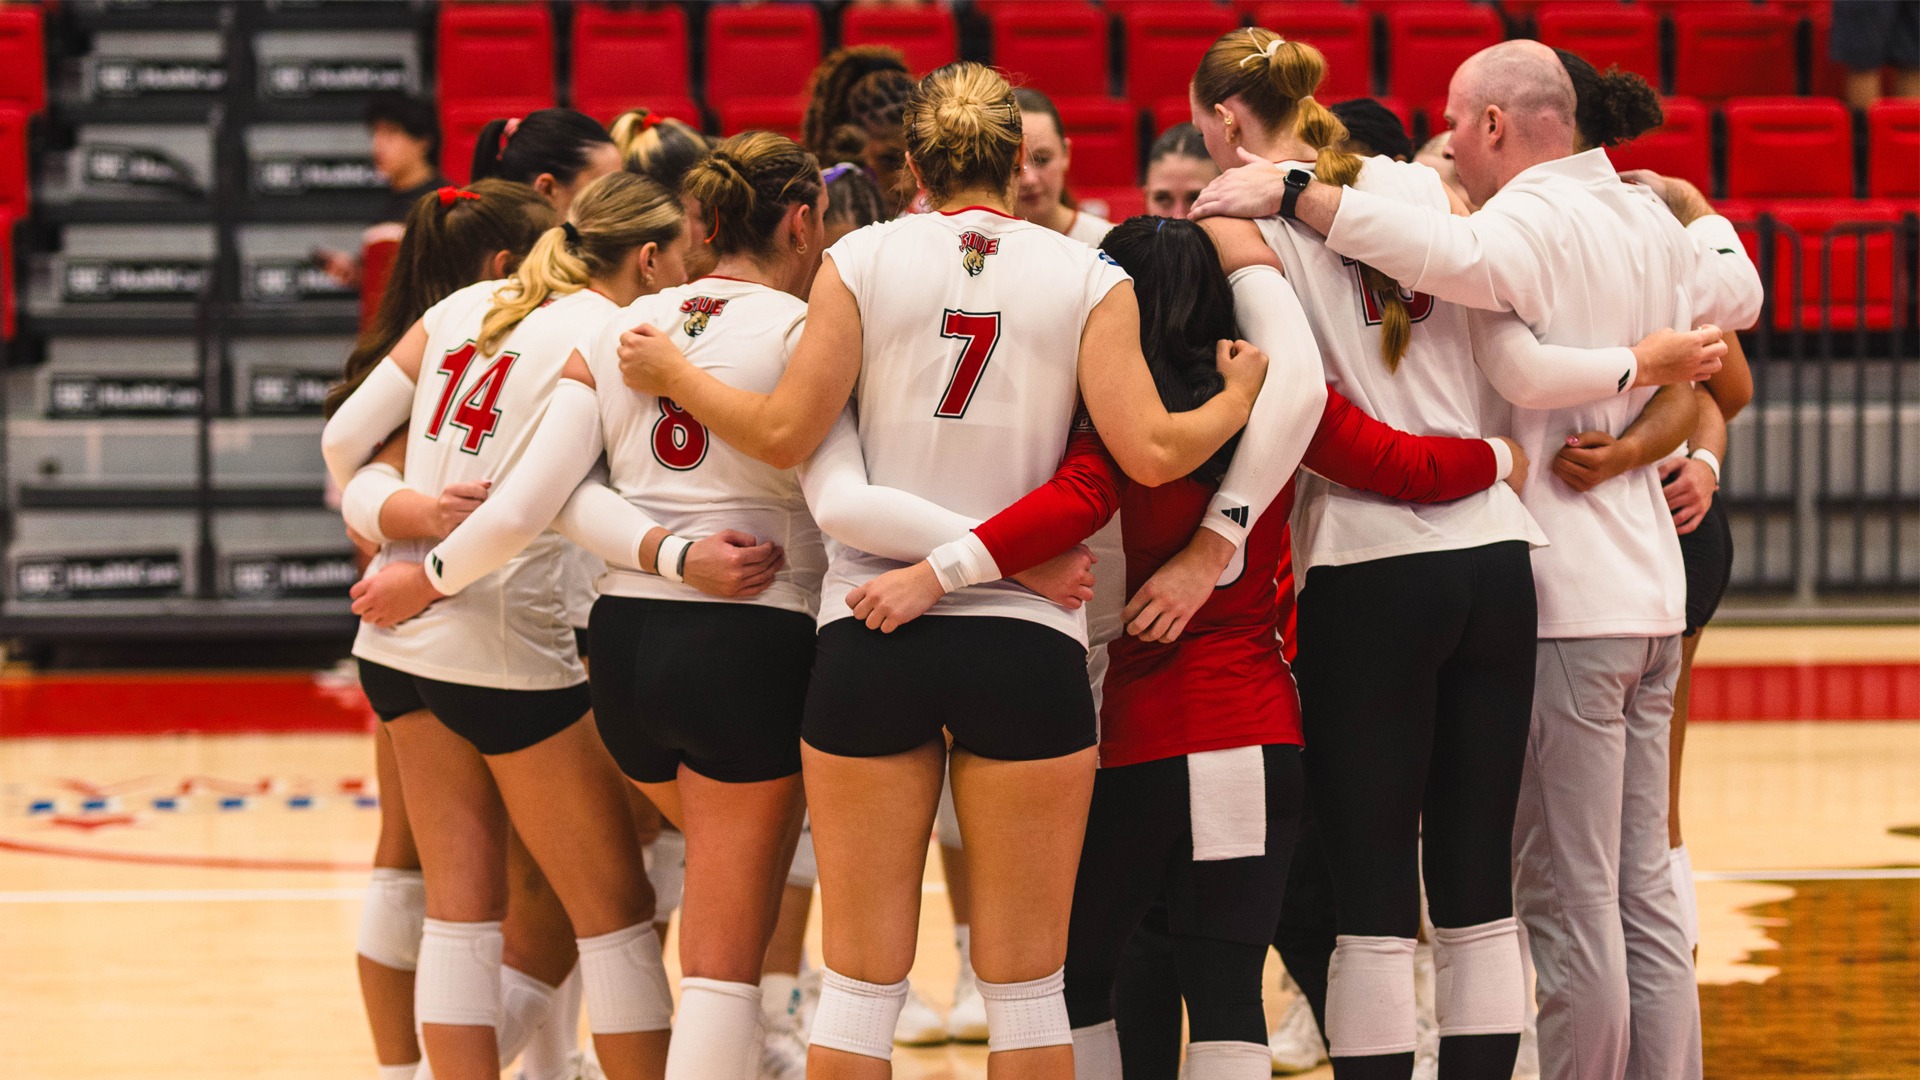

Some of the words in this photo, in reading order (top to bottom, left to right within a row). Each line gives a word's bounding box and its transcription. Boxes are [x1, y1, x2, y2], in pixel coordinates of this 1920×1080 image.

[959, 231, 1000, 255] SIUE
[425, 338, 521, 456] 14
[934, 308, 1001, 419] 7
[650, 396, 709, 472] 8
